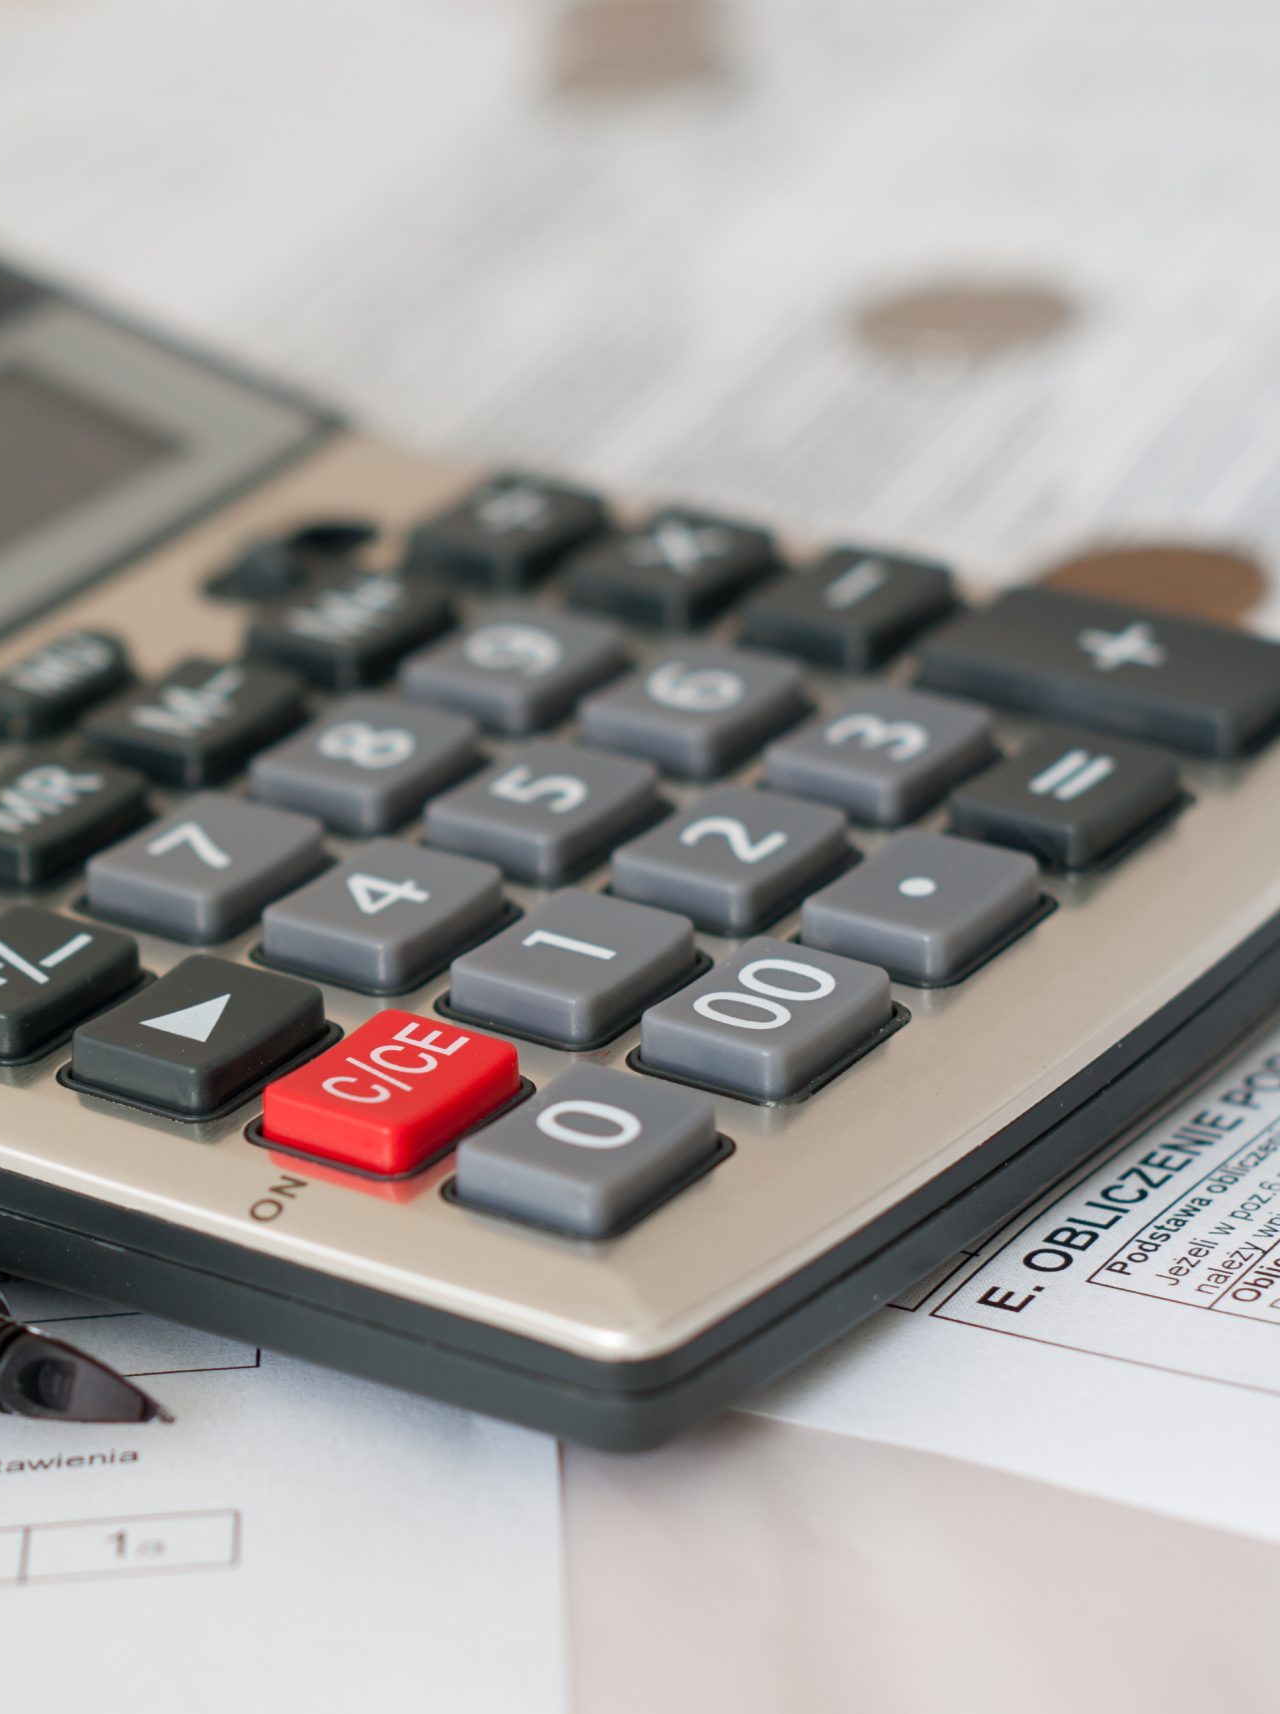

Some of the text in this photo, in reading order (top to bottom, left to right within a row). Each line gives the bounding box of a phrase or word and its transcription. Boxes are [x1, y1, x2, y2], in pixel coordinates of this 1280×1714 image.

[465, 624, 562, 675] 9
[646, 661, 744, 710] 6
[319, 721, 414, 769] 8
[824, 713, 930, 762] 3
[491, 766, 587, 813] 5
[147, 822, 231, 869] 7
[681, 815, 787, 863] 2
[346, 874, 429, 915] 4
[522, 929, 616, 960] 1
[693, 958, 837, 1031] 00
[321, 1022, 470, 1104] C/CE
[535, 1099, 642, 1149] 0
[249, 1174, 308, 1223] ON
[977, 1285, 1045, 1313] E.
[1023, 1110, 1244, 1273] OBLICZENIE
[1105, 1197, 1213, 1276] Podstawa
[1155, 1237, 1219, 1286] Jeżeli
[1208, 1222, 1236, 1235] w
[1195, 1241, 1267, 1295] należy
[1231, 1258, 1280, 1302] Obli
